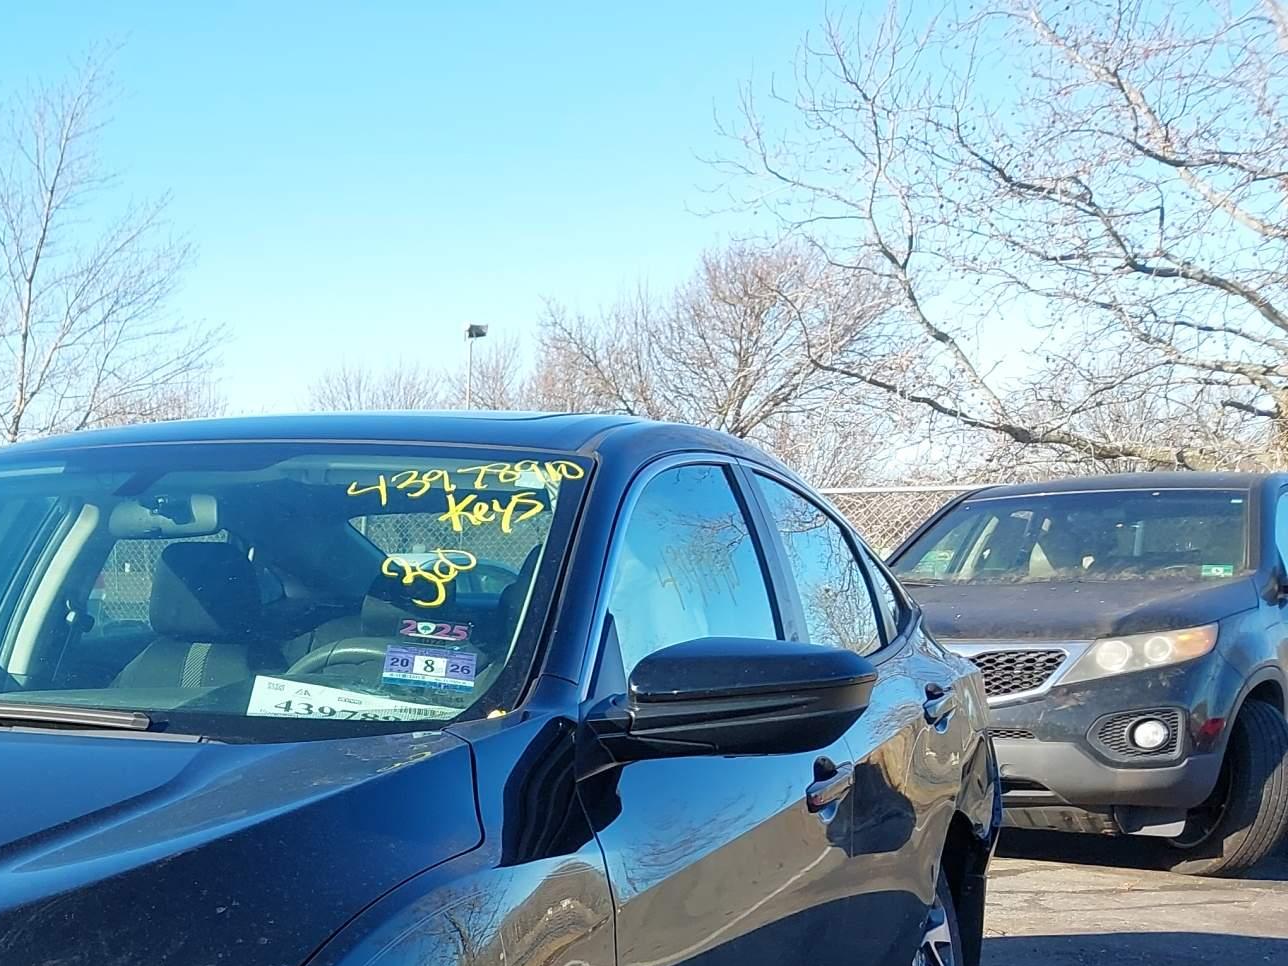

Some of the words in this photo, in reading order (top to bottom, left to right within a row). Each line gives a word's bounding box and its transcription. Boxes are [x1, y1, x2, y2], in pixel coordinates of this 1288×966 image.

[390, 657, 410, 668] 20
[423, 659, 435, 673] 8
[449, 664, 471, 675] 26
